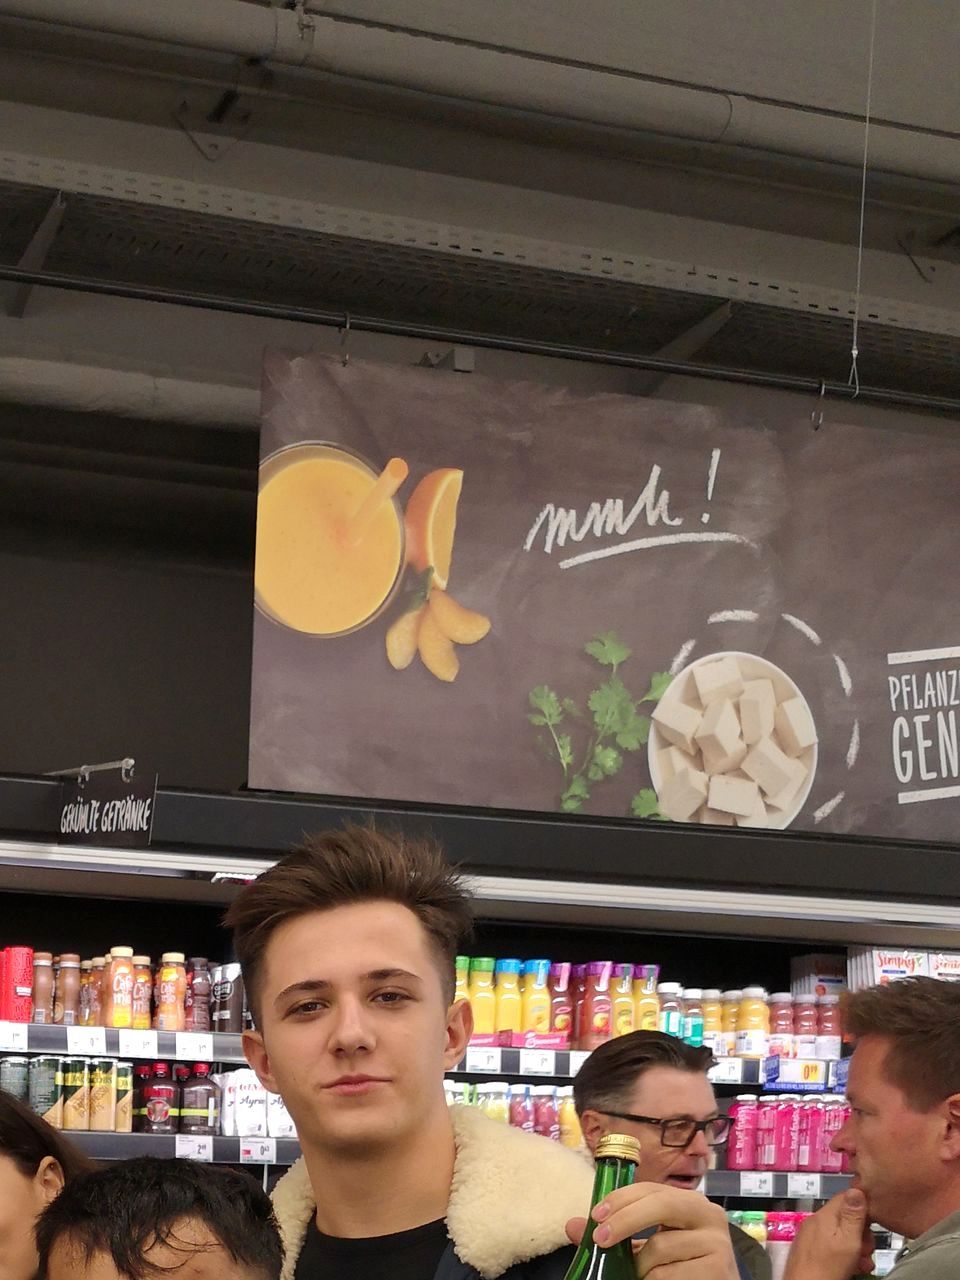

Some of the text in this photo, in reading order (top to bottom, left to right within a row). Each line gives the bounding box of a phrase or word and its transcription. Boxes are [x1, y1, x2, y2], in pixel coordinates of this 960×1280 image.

[888, 670, 960, 711] PFLANZ
[893, 711, 959, 783] GEN
[101, 794, 151, 832] GETRÄNKE
